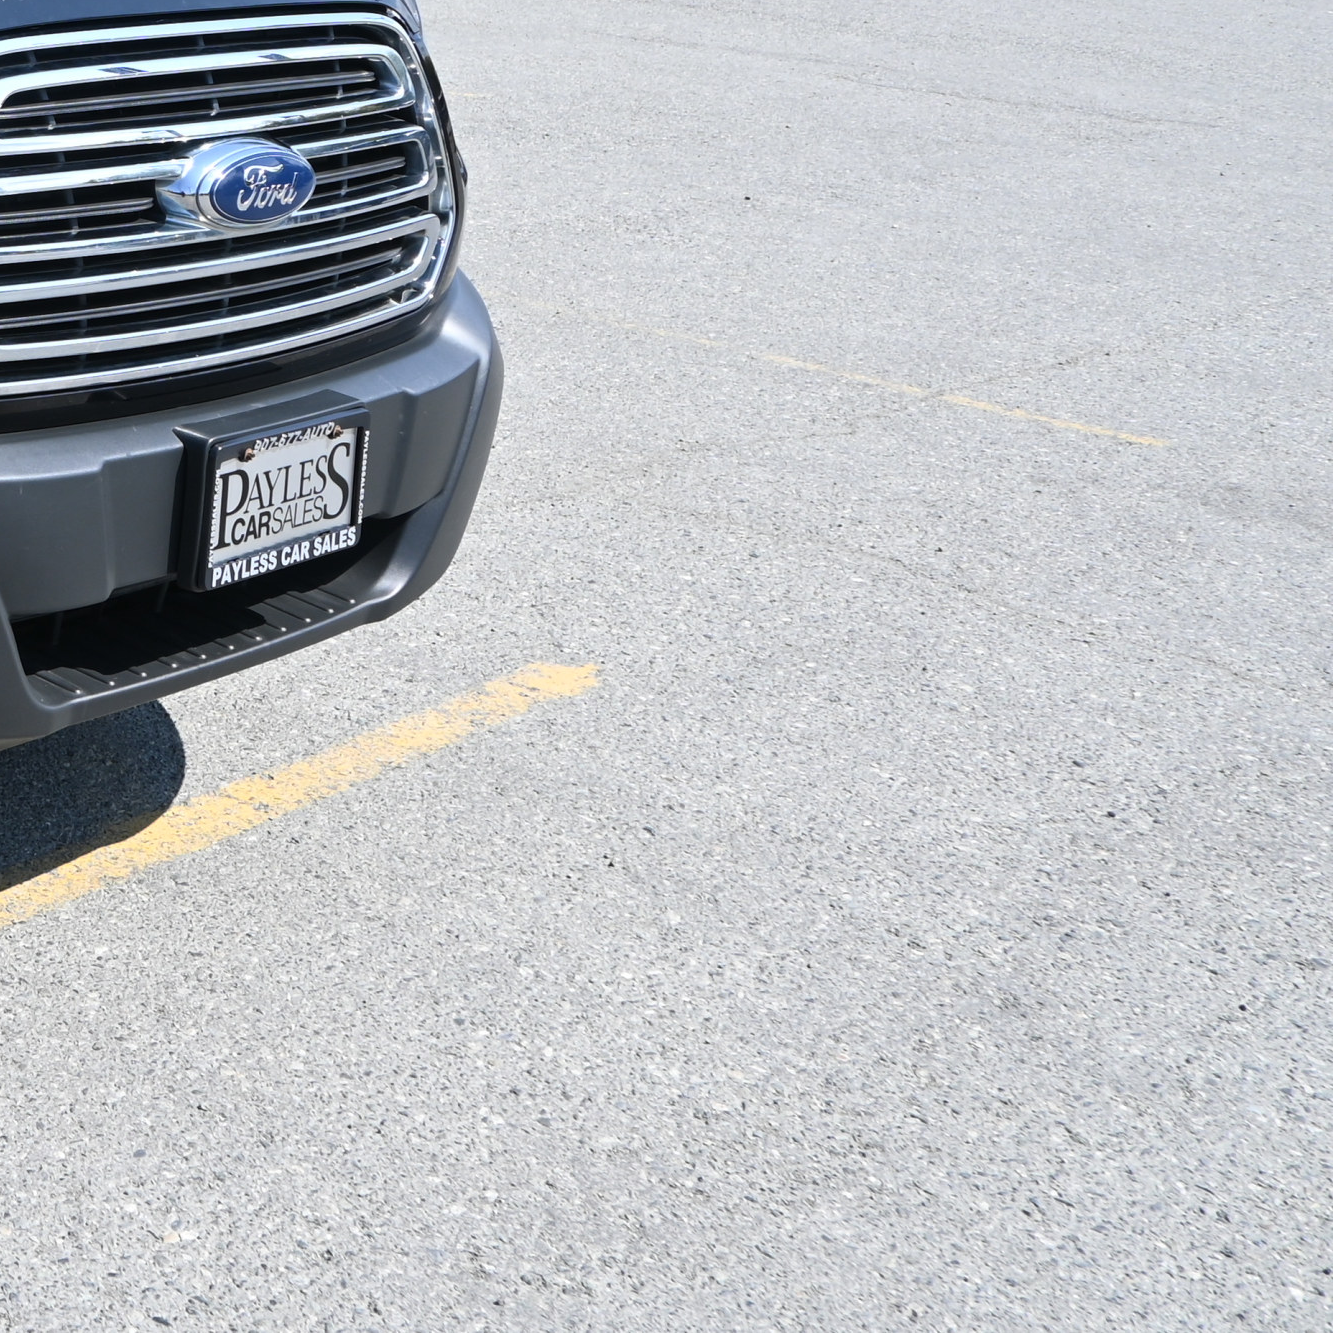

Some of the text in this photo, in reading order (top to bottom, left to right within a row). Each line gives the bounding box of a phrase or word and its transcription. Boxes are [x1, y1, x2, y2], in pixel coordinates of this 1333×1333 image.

[237, 163, 298, 211] Ford
[254, 422, 335, 452] 907-677-AUTO
[212, 442, 351, 550] PAYLESS
[212, 525, 356, 587] PAYLESS CAR SALES
